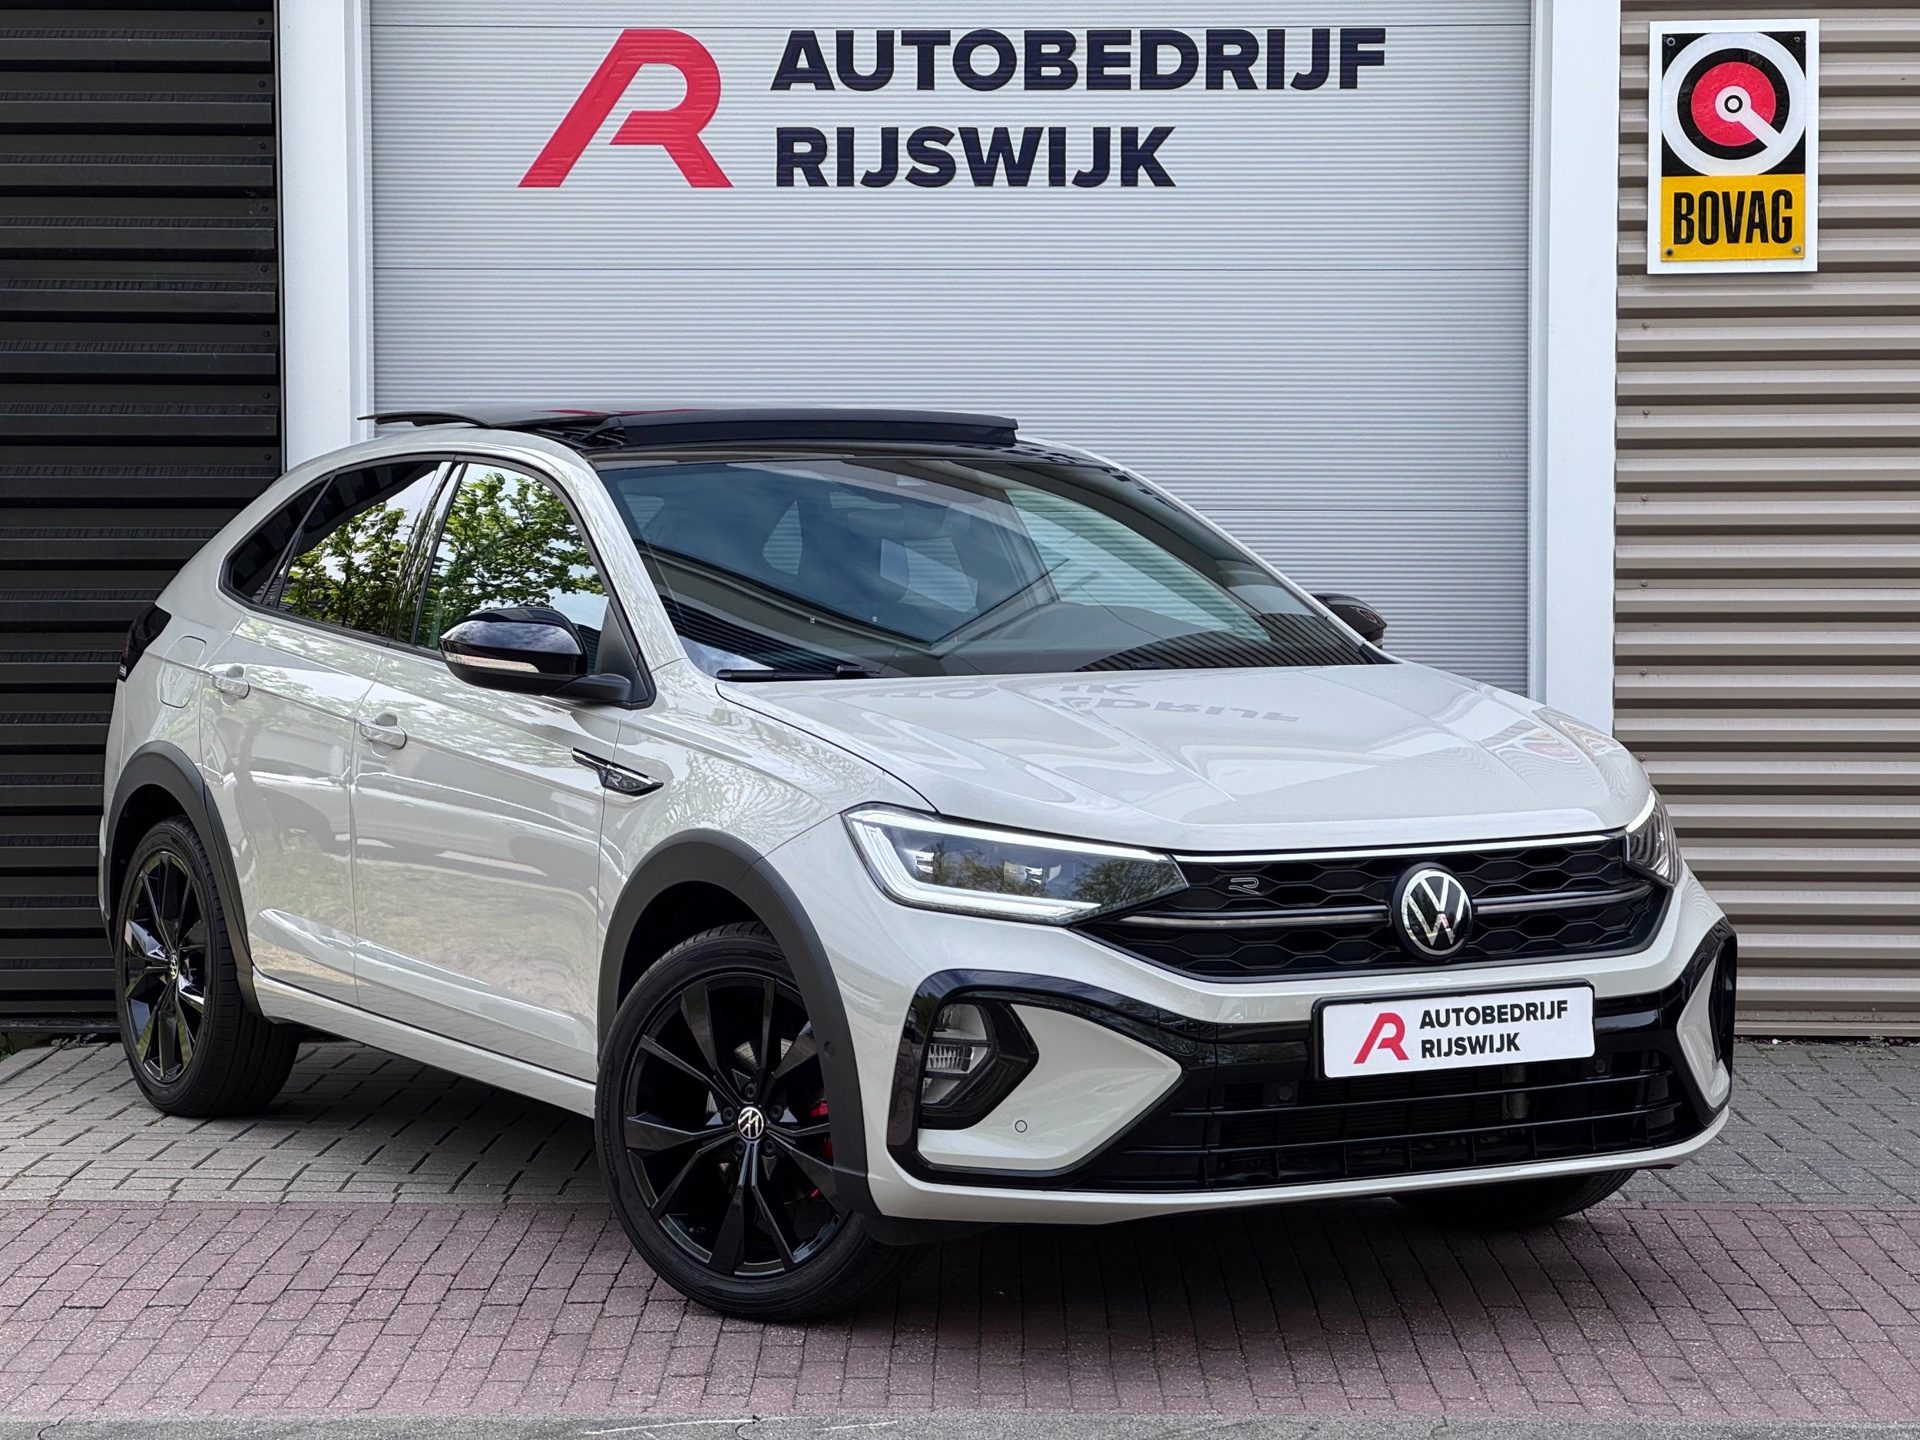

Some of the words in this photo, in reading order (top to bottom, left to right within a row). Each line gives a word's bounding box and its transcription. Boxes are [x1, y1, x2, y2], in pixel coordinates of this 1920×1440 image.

[770, 28, 1387, 91] AUTOBEDRIJF
[777, 126, 1177, 187] RIJSWIJK
[1673, 189, 1793, 245] BOVAG
[1419, 999, 1568, 1029] AUTOBEDRIJF
[1420, 1032, 1521, 1058] RIJSWIJK
